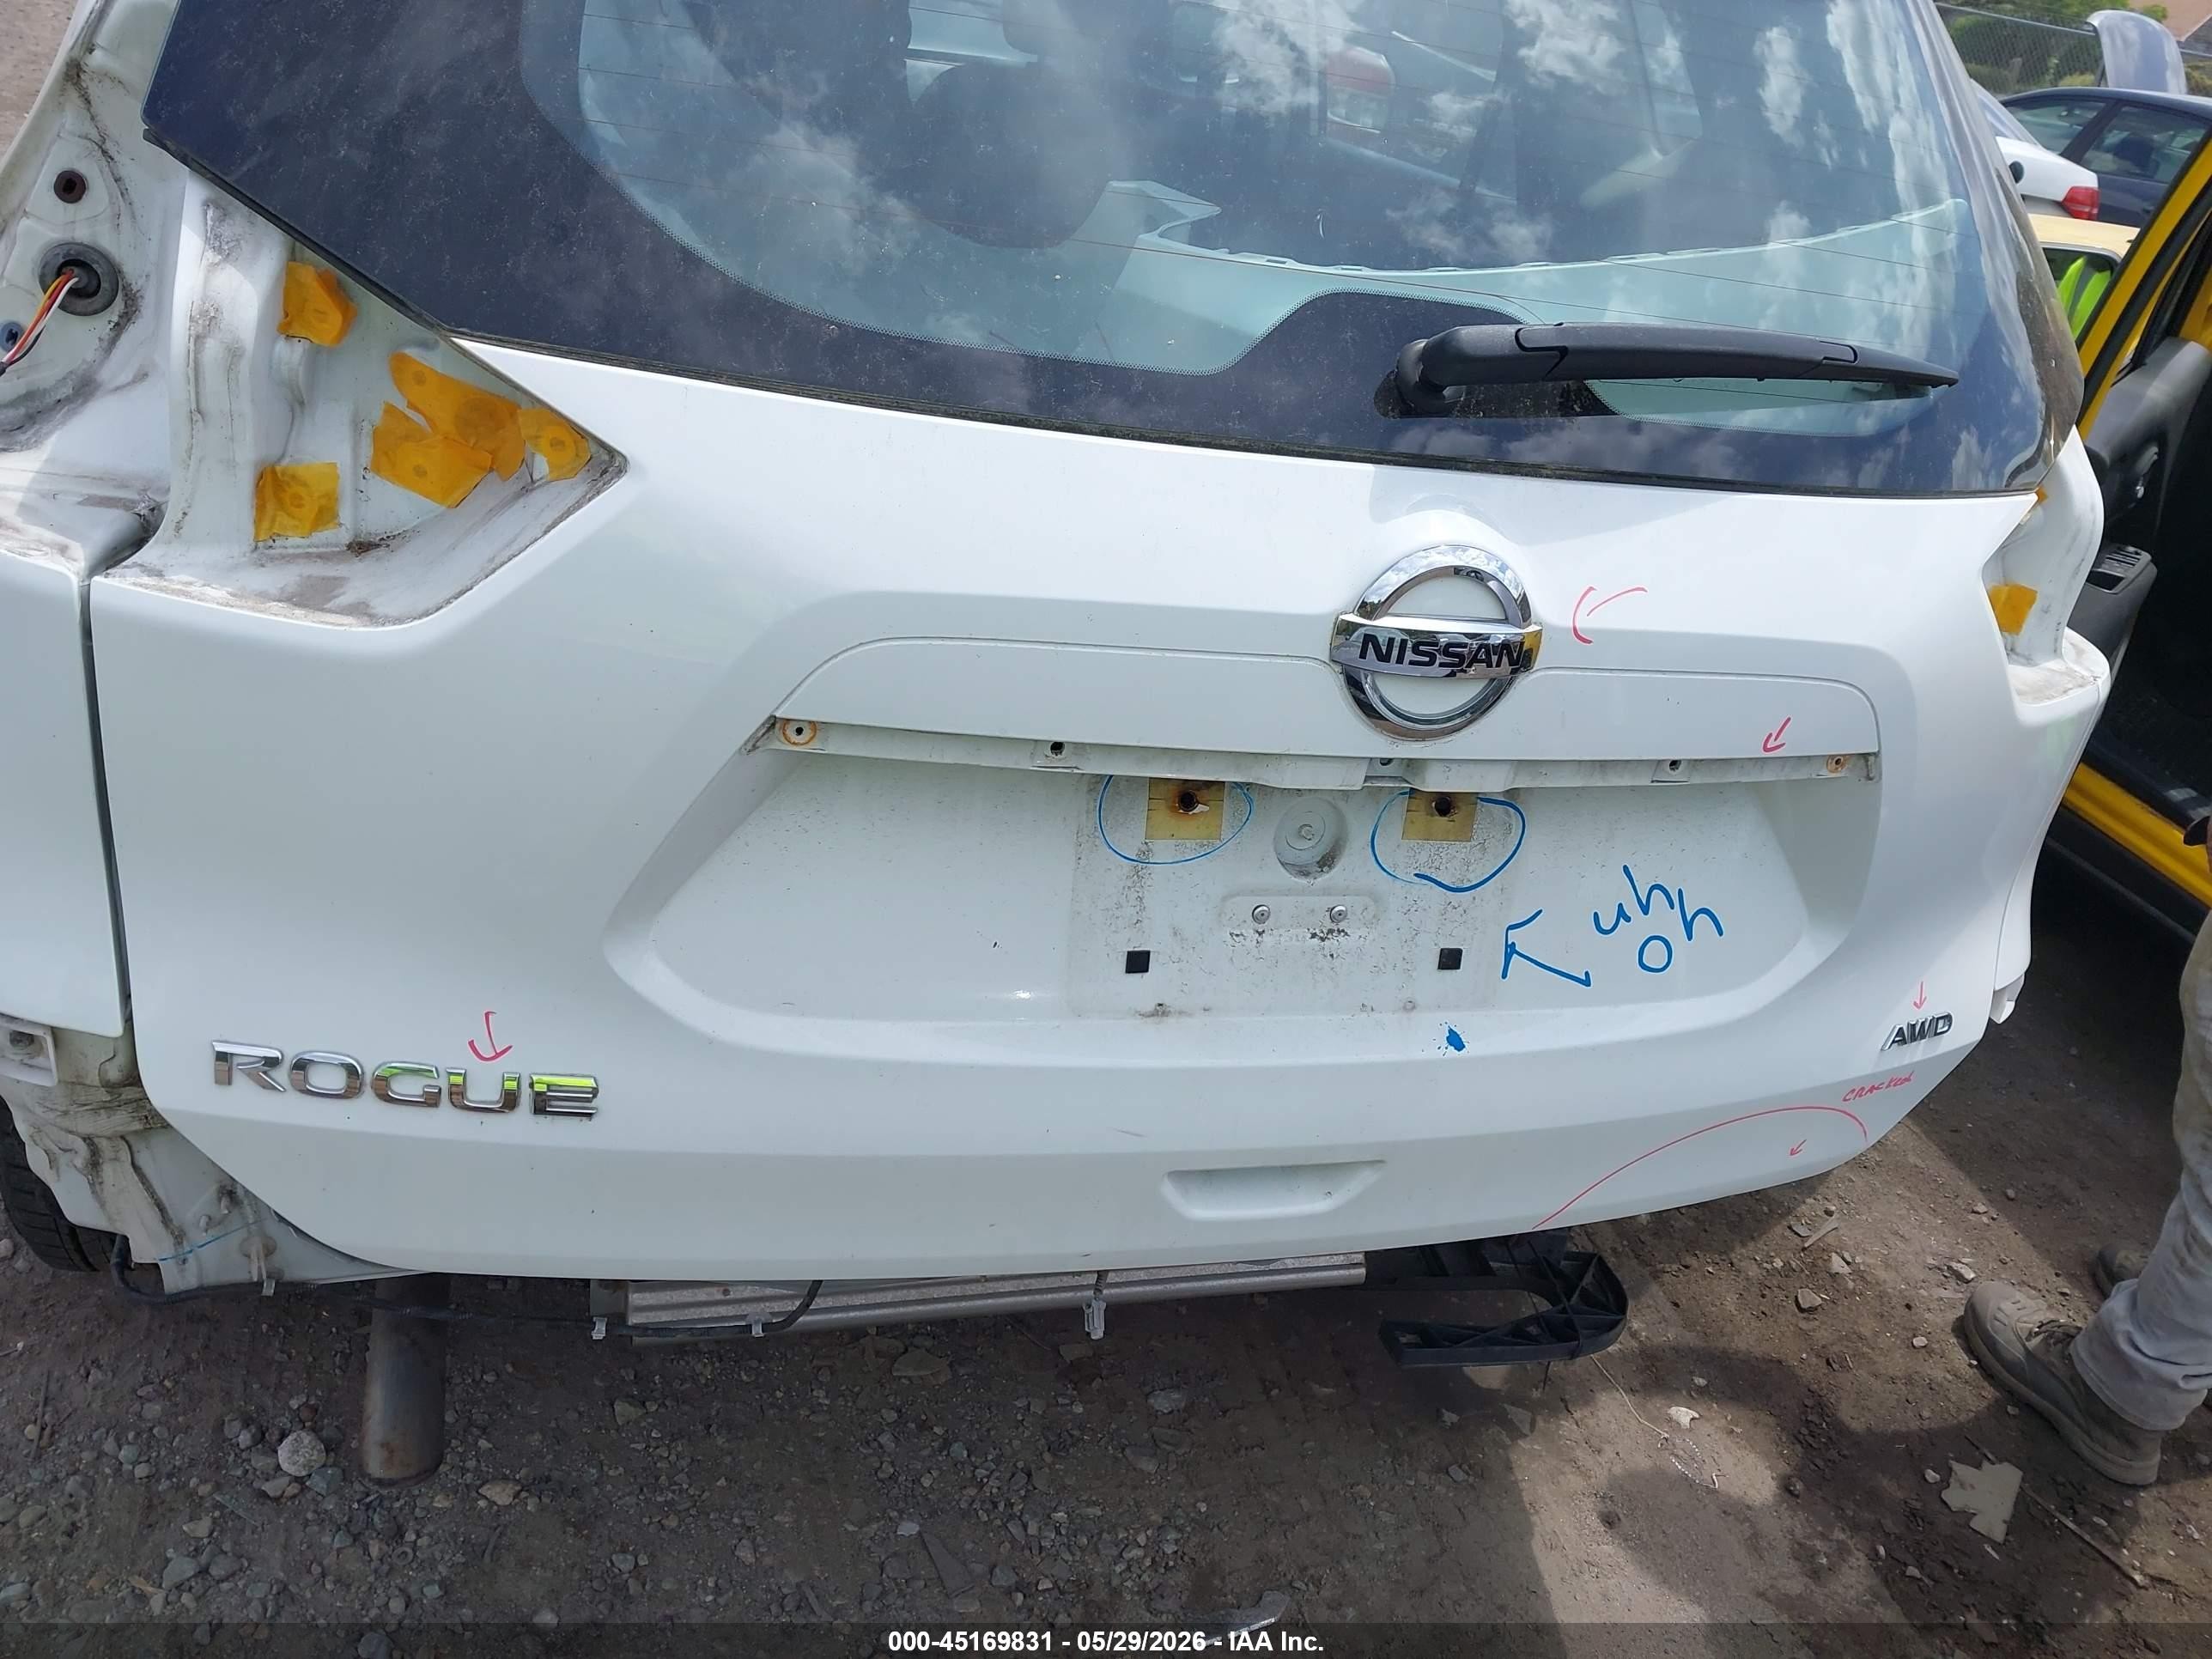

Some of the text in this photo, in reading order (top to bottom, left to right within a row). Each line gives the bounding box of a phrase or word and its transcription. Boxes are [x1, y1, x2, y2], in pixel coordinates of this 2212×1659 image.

[1358, 633, 1525, 670] NISSAN
[1880, 1012, 1954, 1051] AWD
[211, 1040, 600, 1116] ROGUE
